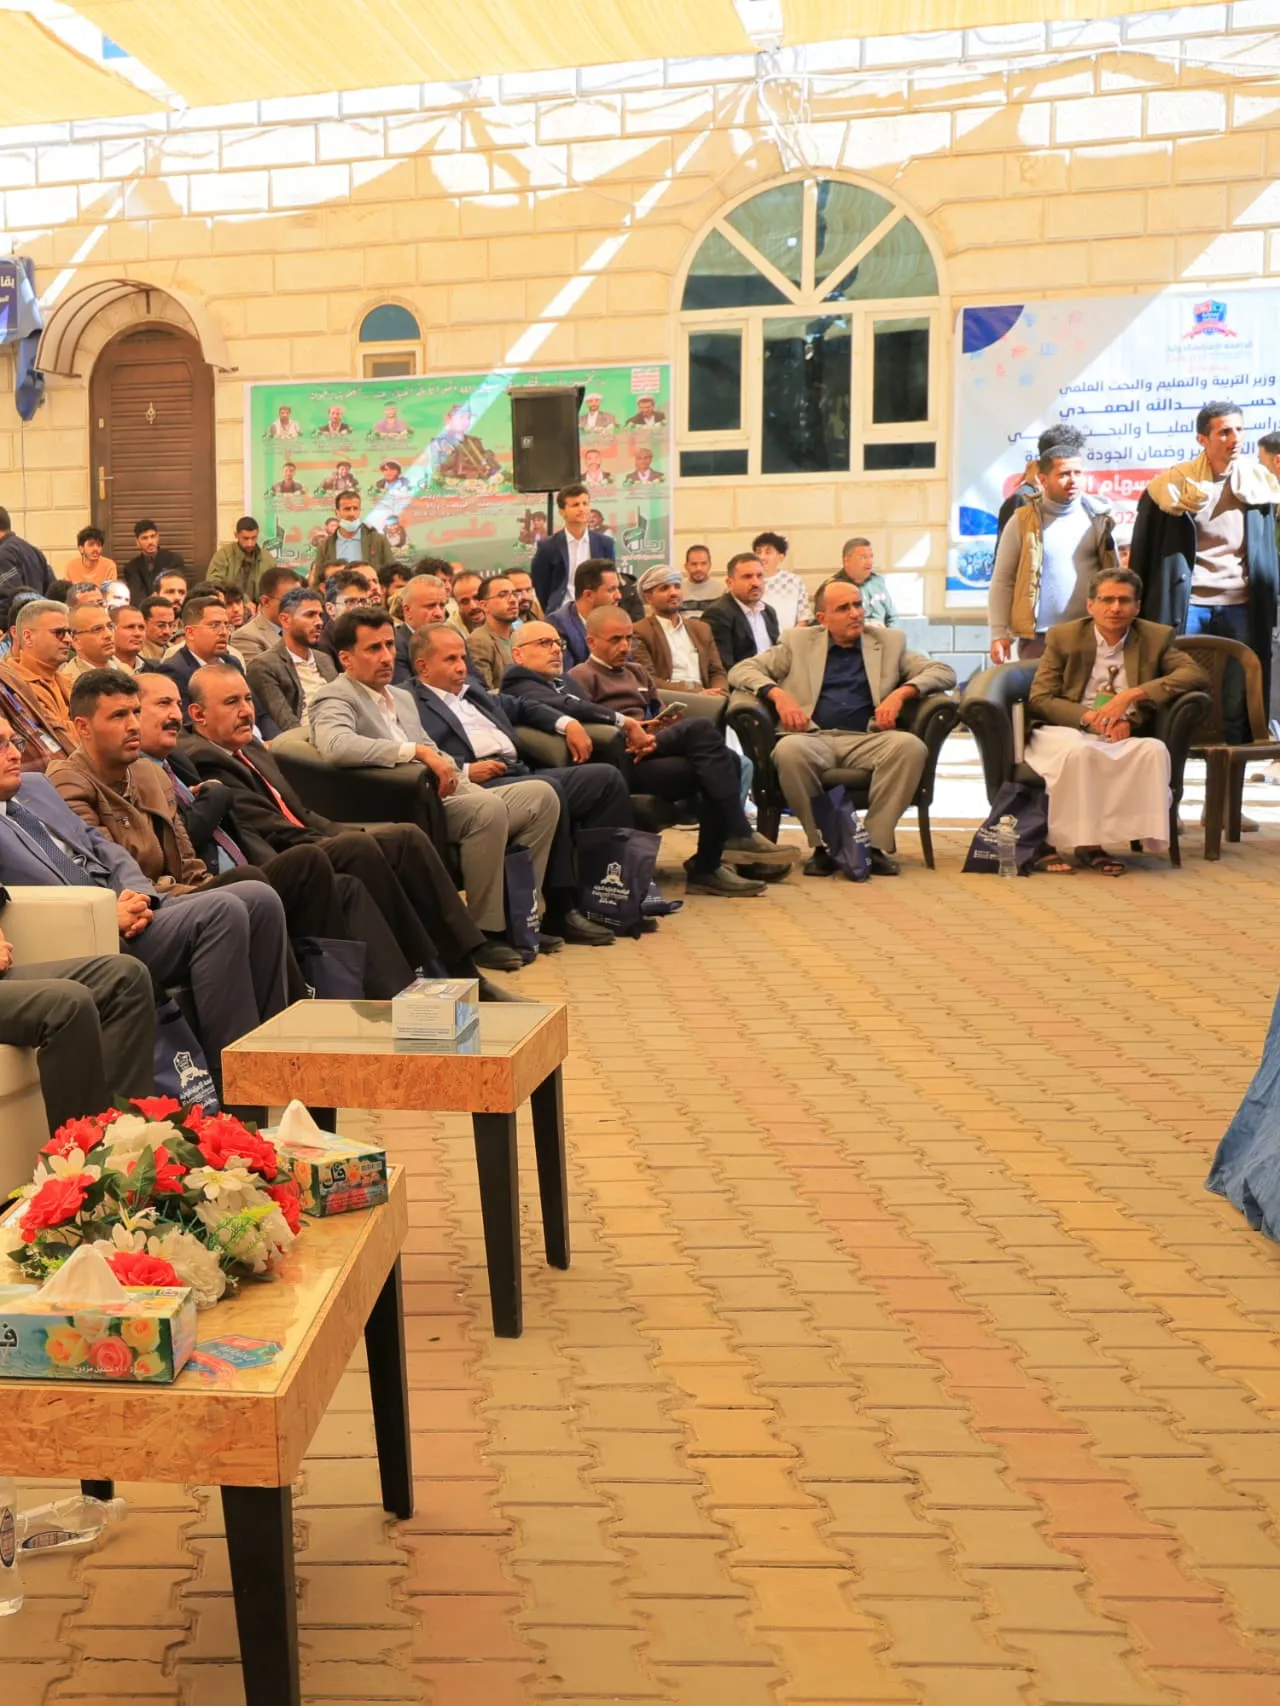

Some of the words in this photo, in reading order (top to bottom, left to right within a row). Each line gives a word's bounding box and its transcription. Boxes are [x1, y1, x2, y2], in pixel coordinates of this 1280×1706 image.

[1059, 380, 1104, 396] العلمي
[1108, 377, 1152, 391] والبحث
[1156, 376, 1208, 392] والتعليم
[1212, 374, 1249, 390] التربية
[1253, 374, 1276, 388] وزير
[1059, 400, 1140, 419] الصعدي
[1147, 420, 1194, 437] لعليا
[1086, 447, 1132, 463] الجودة
[1137, 446, 1186, 460] وضمان
[322, 1161, 347, 1189] فل
